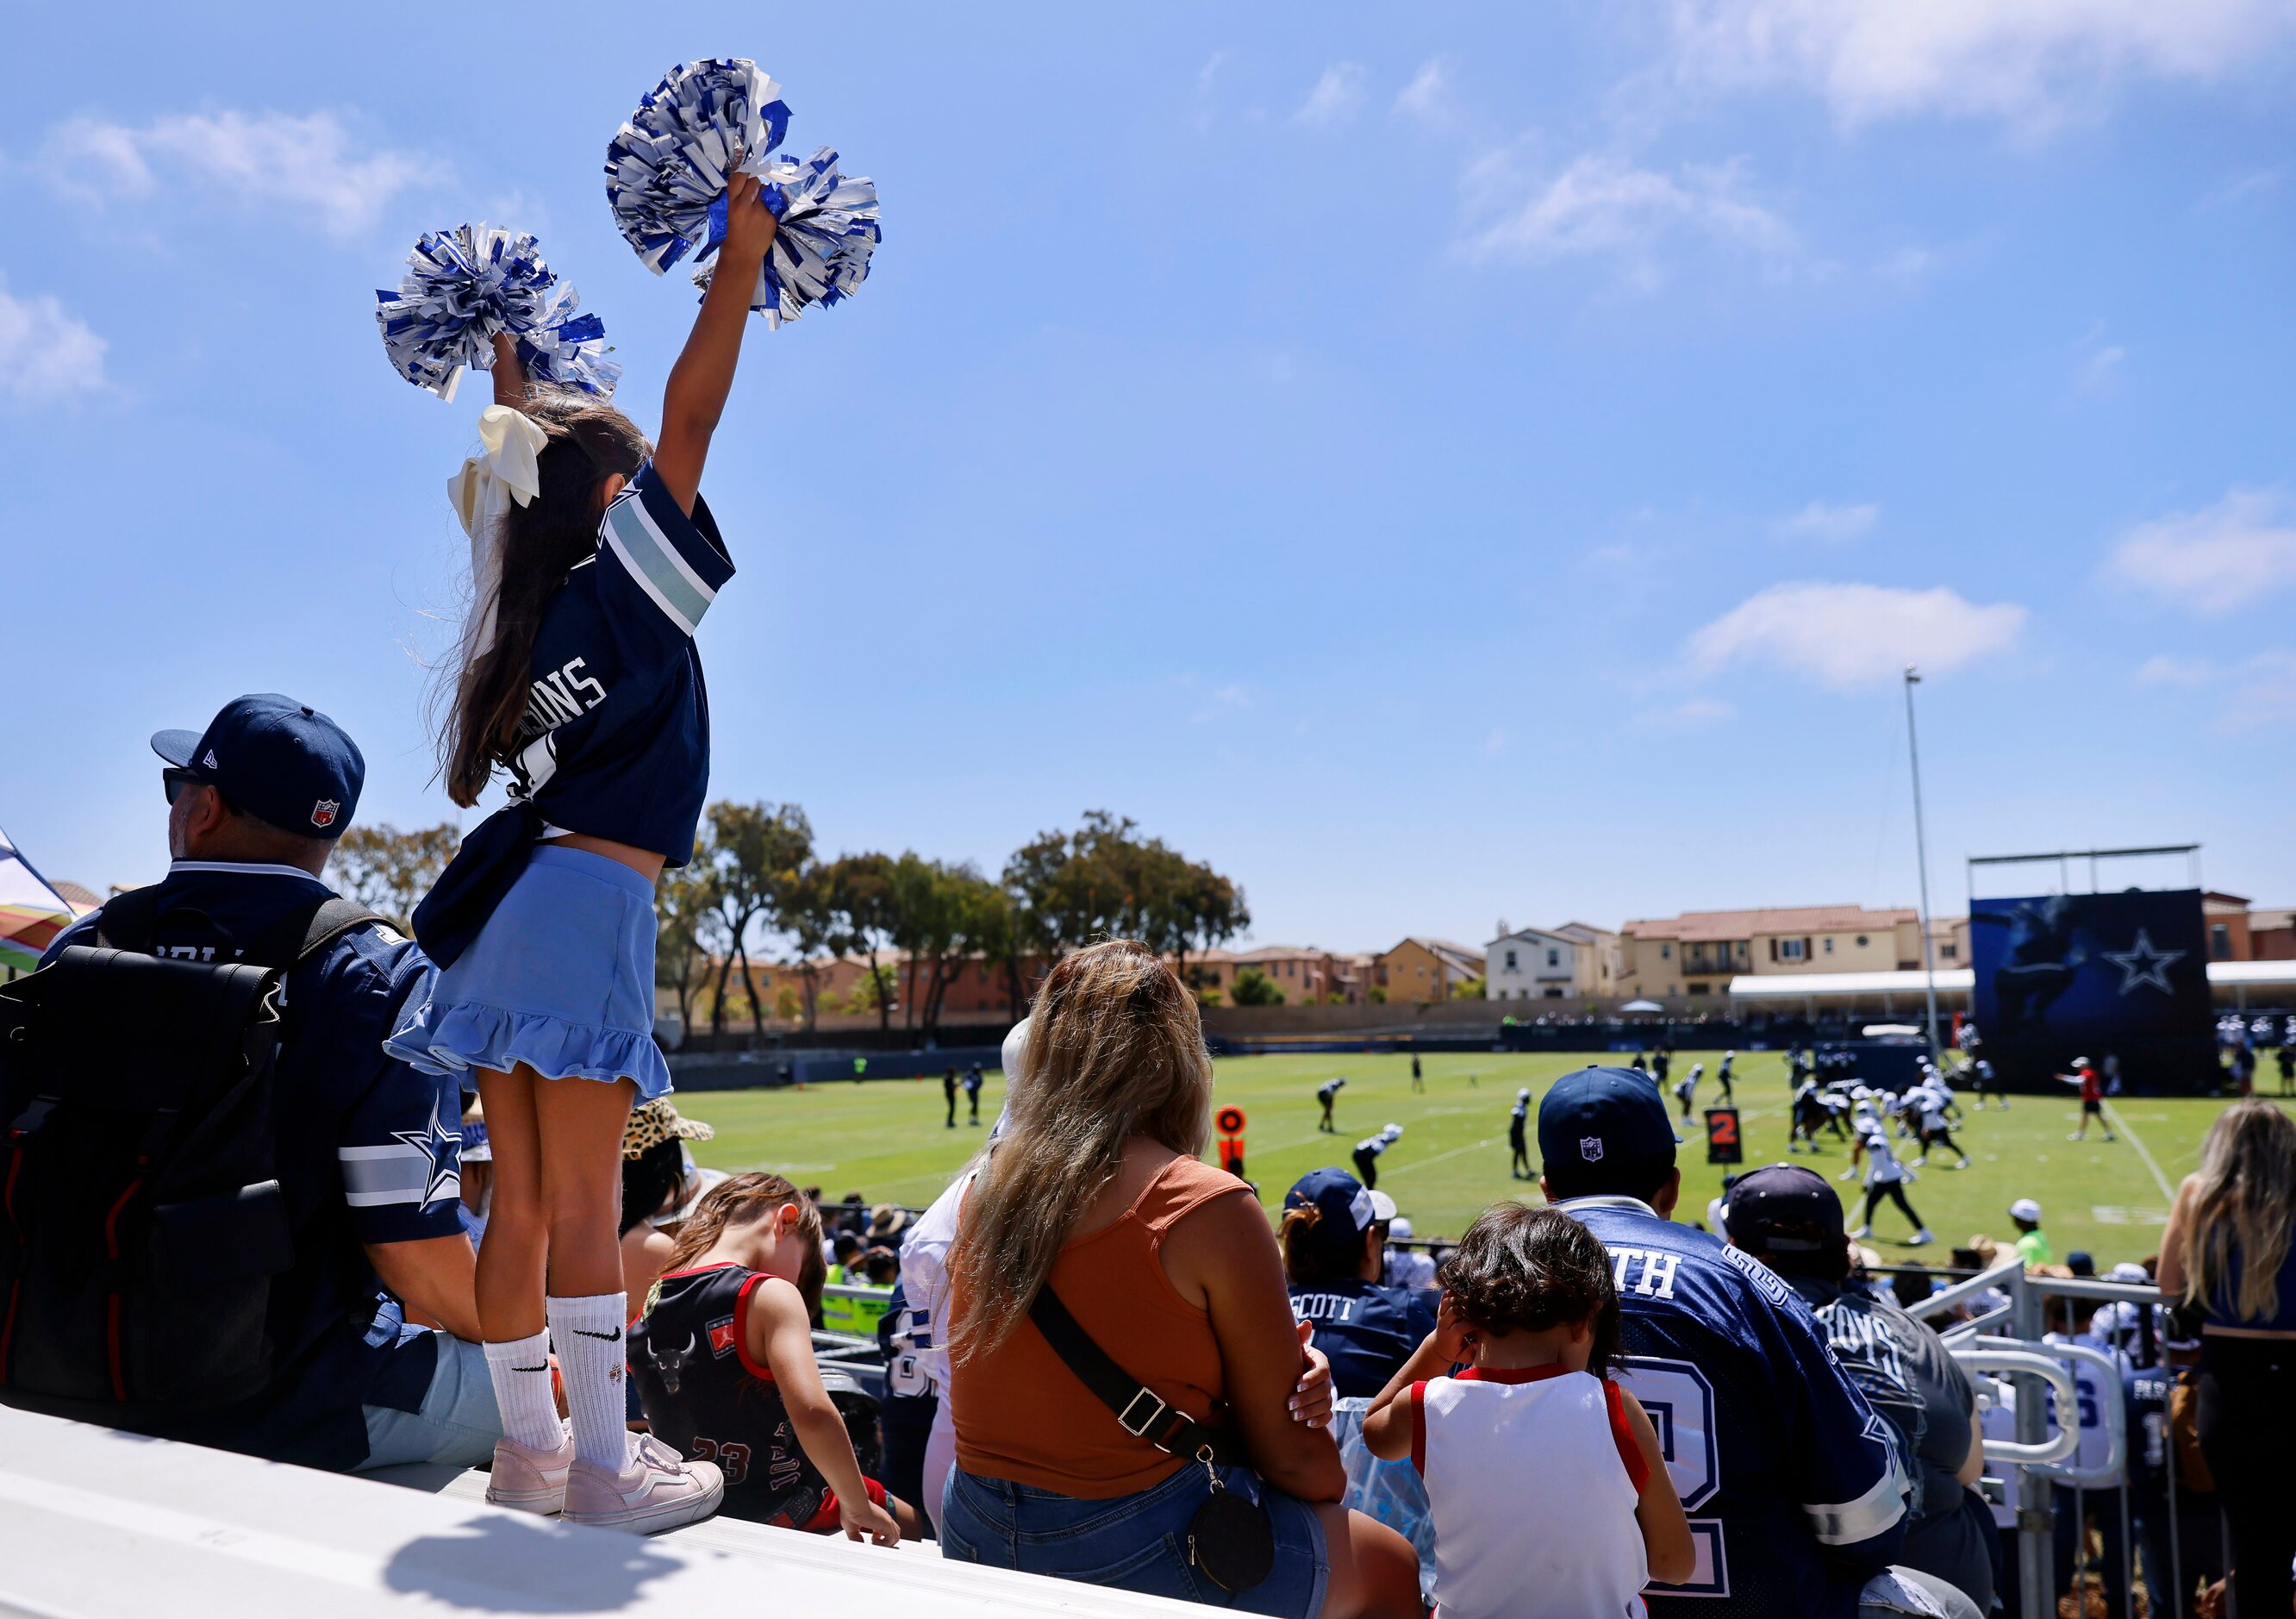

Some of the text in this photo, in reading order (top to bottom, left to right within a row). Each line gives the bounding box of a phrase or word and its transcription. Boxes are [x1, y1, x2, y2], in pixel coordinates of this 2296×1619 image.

[1710, 1113, 1737, 1144] 2
[1606, 1247, 1682, 1299] TH
[1289, 1294, 1357, 1321] SCOTT
[689, 1435, 751, 1486] 23
